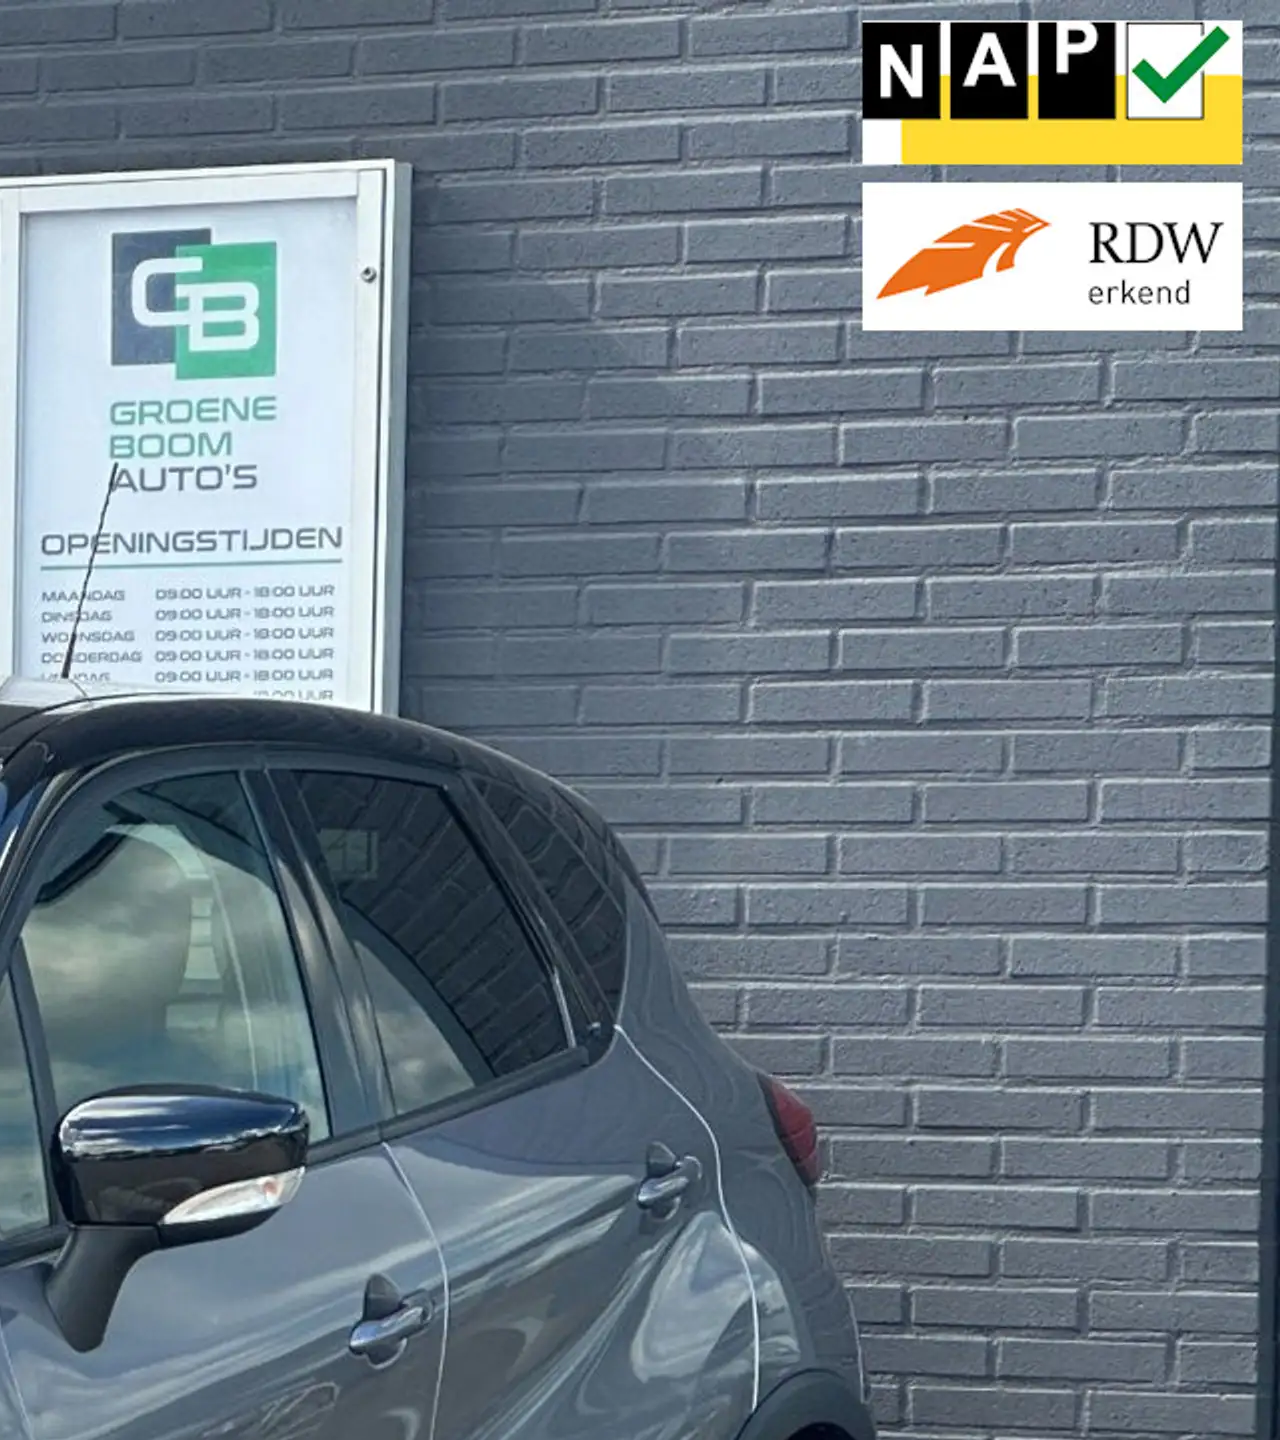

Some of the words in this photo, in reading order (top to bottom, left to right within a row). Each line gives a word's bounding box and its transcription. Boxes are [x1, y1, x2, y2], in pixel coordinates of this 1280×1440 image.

[109, 396, 277, 426] GROENE
[109, 431, 232, 459] BOOM
[111, 464, 258, 492] AUTO'S
[41, 526, 343, 556] OPENINGSTIJDEN
[206, 588, 241, 600] UUR
[299, 585, 335, 597] UUR
[206, 608, 241, 620] UUR
[299, 606, 335, 618] UUR
[42, 630, 135, 643] WONSDAG
[206, 629, 241, 641] UUR
[299, 627, 335, 639] UUR
[42, 651, 142, 663] DODERDAG
[206, 650, 241, 661] UUR
[299, 648, 335, 660] UUR
[206, 671, 241, 682] UUR
[299, 668, 335, 680] UUR
